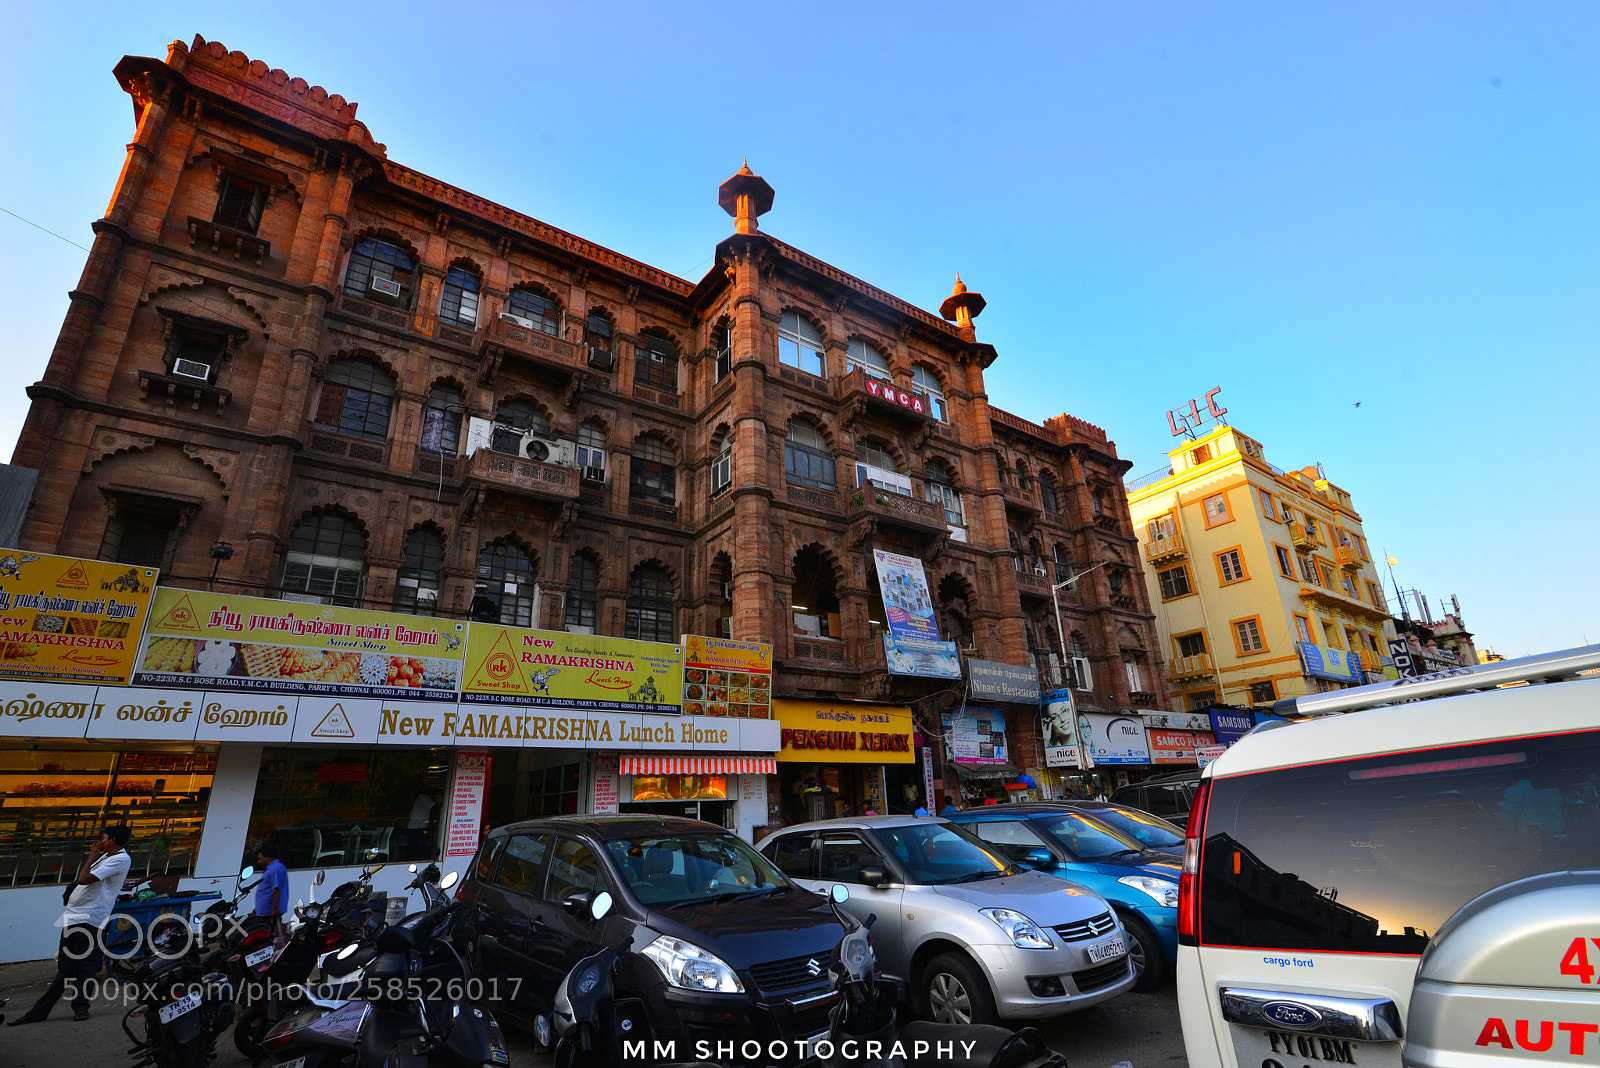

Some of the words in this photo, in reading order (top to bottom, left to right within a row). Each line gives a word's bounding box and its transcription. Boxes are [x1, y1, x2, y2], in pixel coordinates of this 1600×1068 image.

[868, 382, 923, 412] YMCA
[1166, 386, 1227, 437] LIC
[207, 605, 244, 632] நியூ
[248, 612, 352, 637] ராமகிருஷ்ணா
[354, 622, 392, 641] லன்ச்
[395, 625, 440, 646] ஹோம்
[326, 638, 359, 648] Sweet
[359, 641, 387, 651] Shop
[522, 635, 555, 649] New
[521, 652, 635, 672] RAMAKRISHNA
[194, 677, 215, 685] BOSE
[477, 680, 500, 688] Sweet
[502, 681, 521, 691] Shop
[973, 679, 1001, 695] Ninan's
[1001, 682, 1041, 699] Restaurant
[116, 700, 195, 723] லன்ச்
[203, 702, 288, 729] ஹோம்
[1217, 716, 1251, 729] SAMSUNG
[380, 709, 434, 736] New
[441, 712, 613, 742] RAMAKRISHNA
[618, 720, 675, 744] Lunch
[681, 723, 729, 744] Home
[781, 728, 857, 751] PENGUIN
[860, 731, 910, 752] XEROX
[1157, 736, 1186, 746] SAMCO
[1187, 737, 1211, 747] PLAZA
[1263, 956, 1291, 967] cargo
[1292, 957, 1314, 968] ford
[1560, 937, 1600, 984] 4
[169, 1001, 180, 1011] TN
[177, 1001, 195, 1014] 9514
[1275, 1005, 1306, 1023] Ford
[1475, 1017, 1600, 1056] AUT
